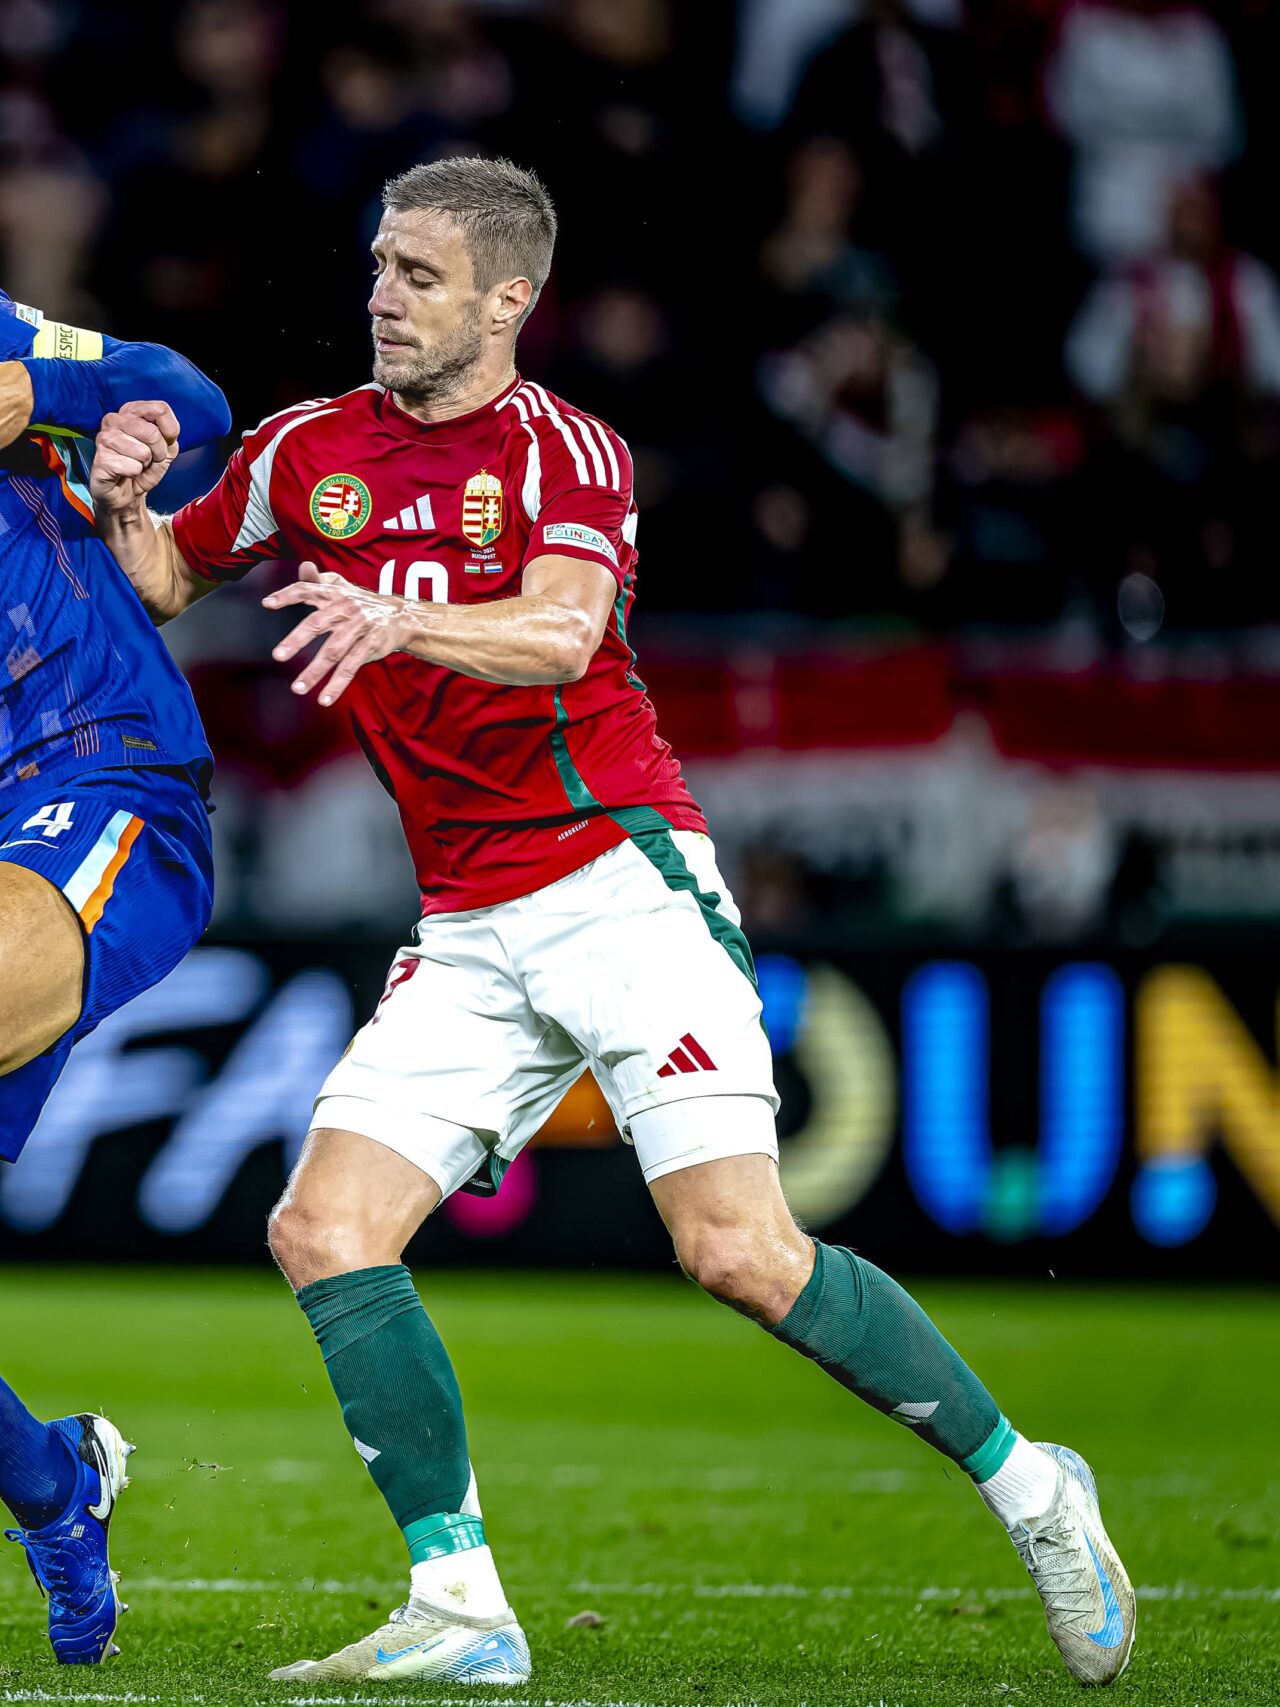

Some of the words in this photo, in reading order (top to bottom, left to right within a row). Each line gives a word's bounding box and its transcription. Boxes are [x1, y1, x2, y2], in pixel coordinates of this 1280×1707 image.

[59, 324, 73, 360] ESPEC
[546, 530, 611, 549] FOUNDATI
[21, 801, 76, 838] 4
